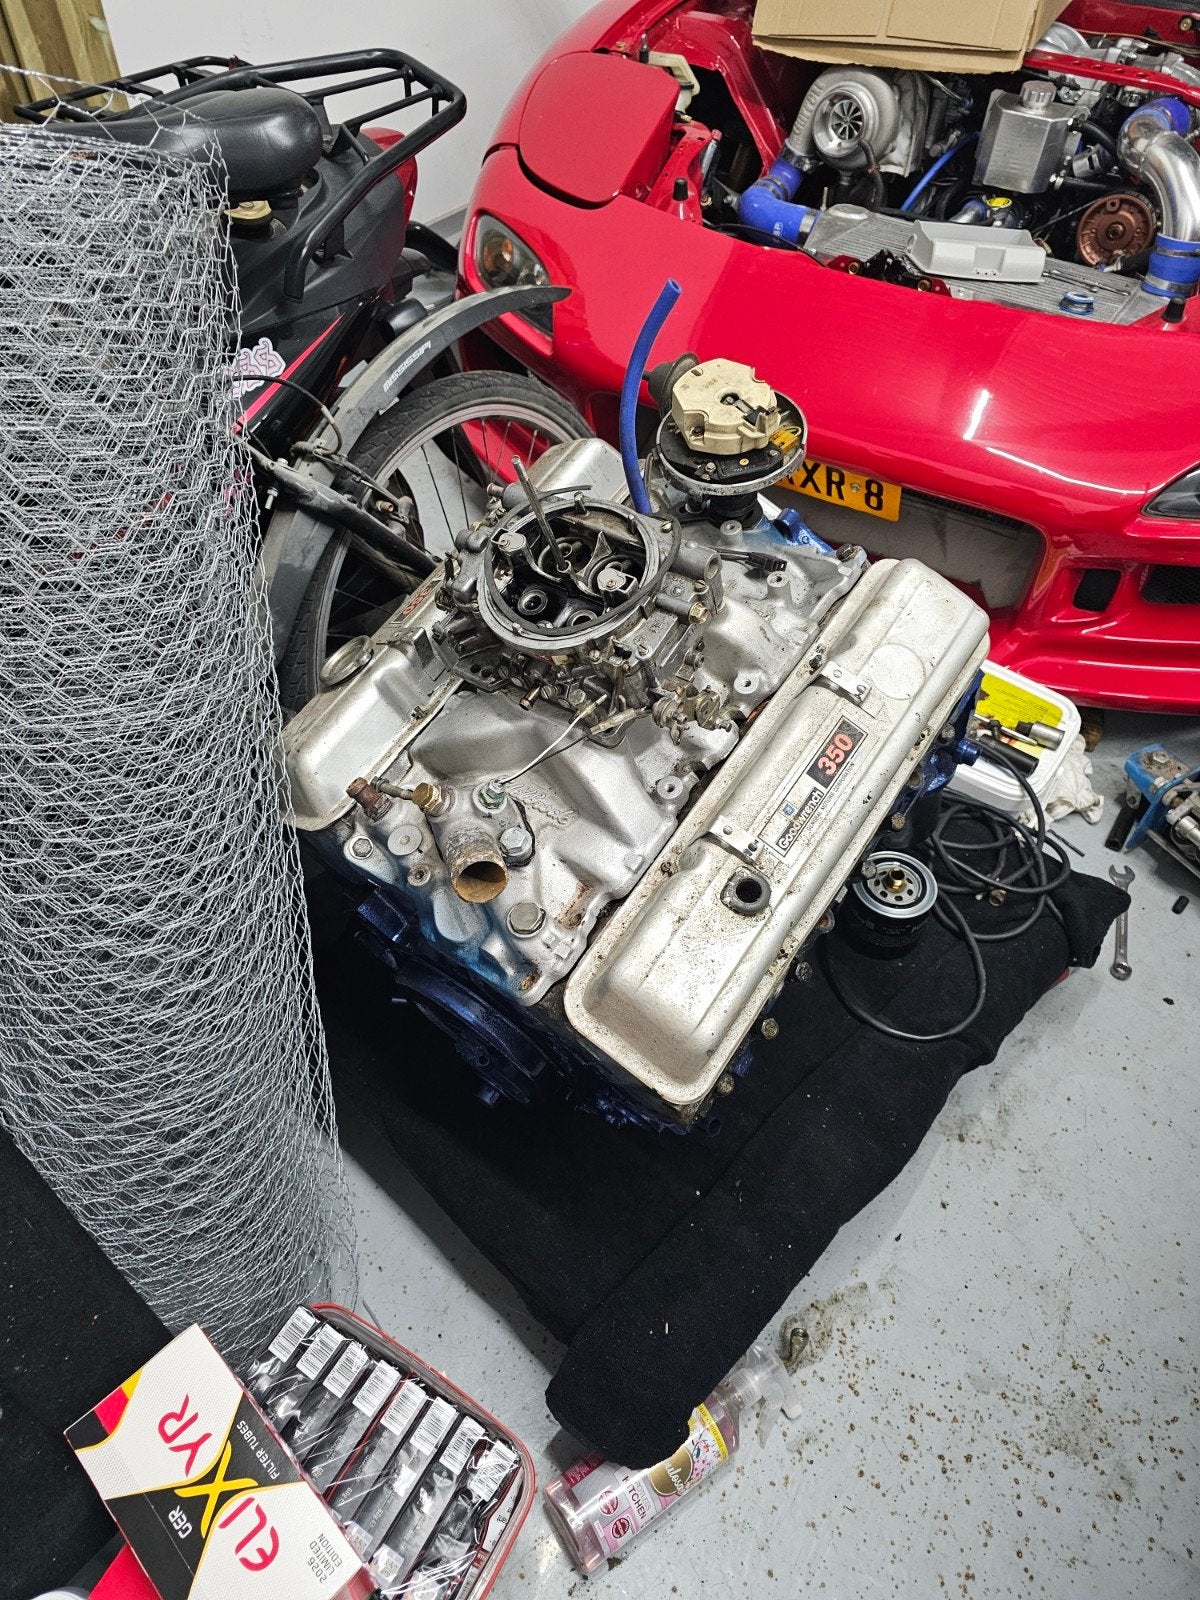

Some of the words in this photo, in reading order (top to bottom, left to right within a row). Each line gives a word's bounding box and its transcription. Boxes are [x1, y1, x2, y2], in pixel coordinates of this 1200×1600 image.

[780, 462, 845, 501] XR
[817, 733, 853, 776] 350
[806, 810, 822, 831] GENERAL
[832, 762, 855, 792] CORPORATION
[778, 789, 824, 850] Goodwrench
[236, 1420, 260, 1448] TUBES
[255, 1450, 280, 1480] FILTER
[618, 1476, 650, 1519] KITCHEN
[168, 1505, 193, 1540] GER
[309, 1540, 336, 1576] LIMITED
[317, 1533, 343, 1568] EDITION
[307, 1557, 328, 1584] 2026
